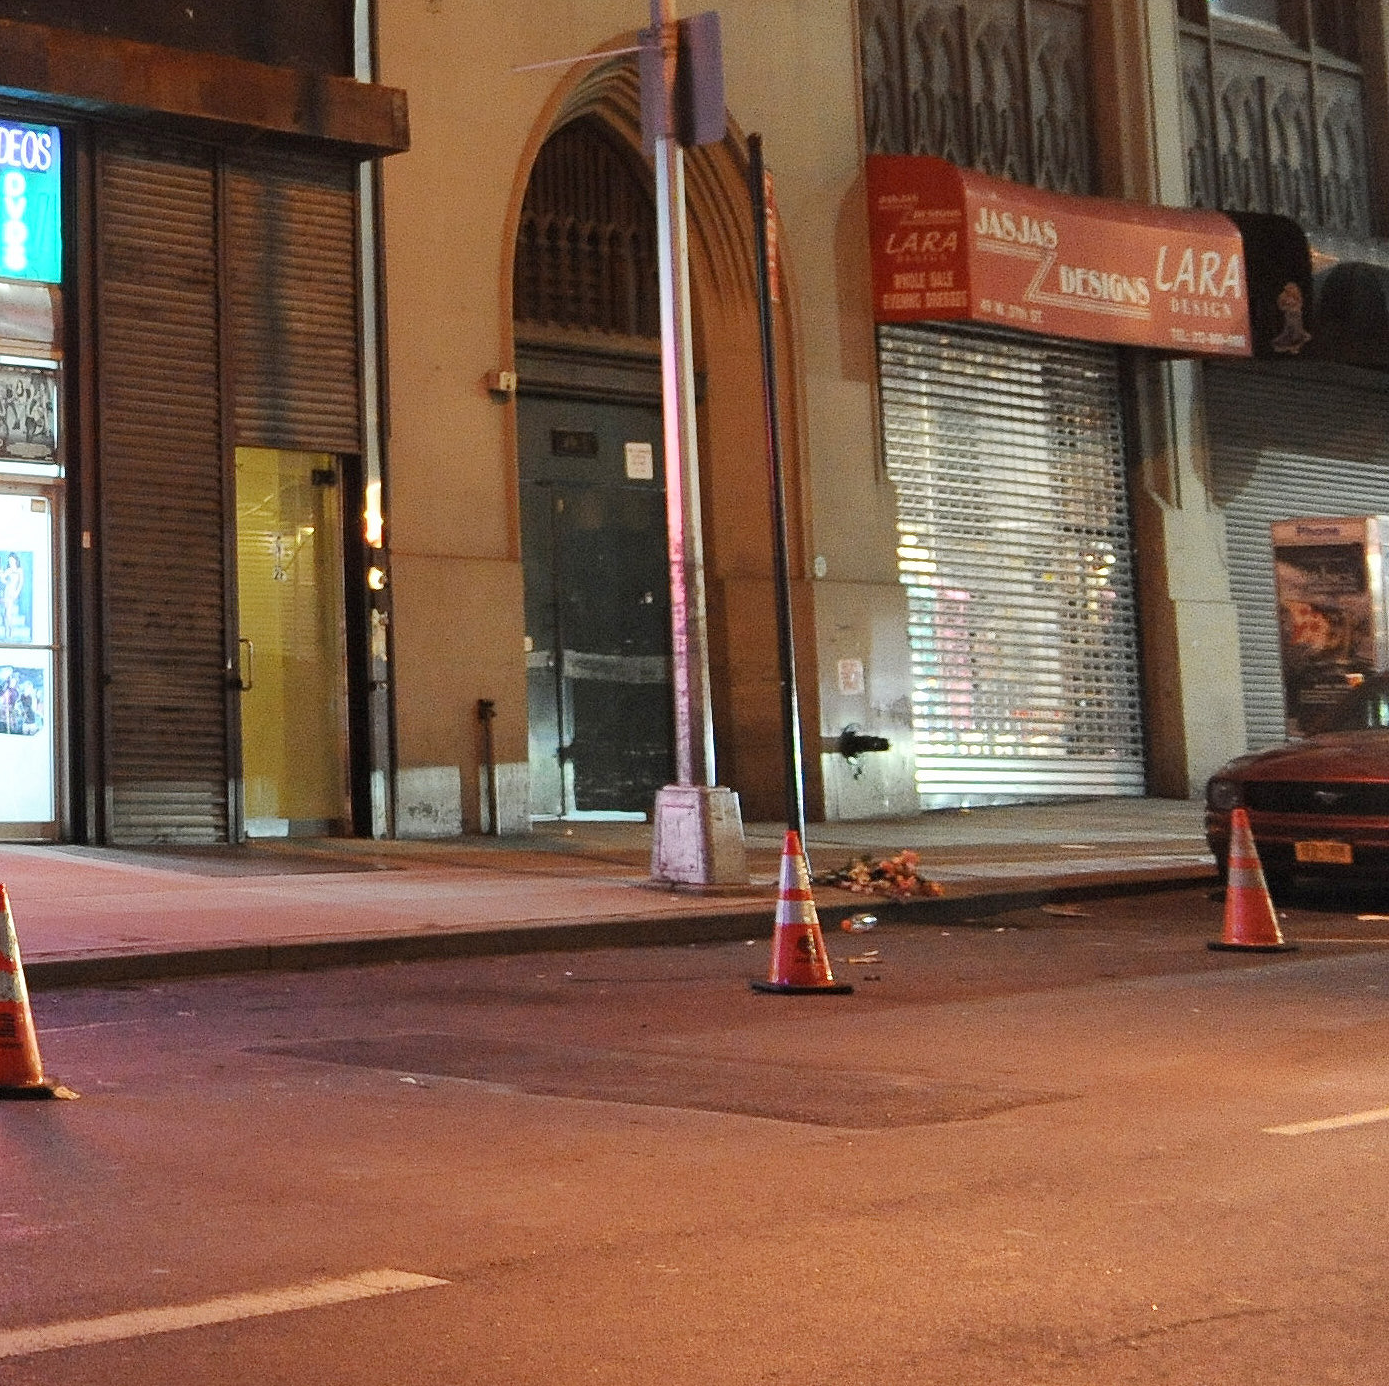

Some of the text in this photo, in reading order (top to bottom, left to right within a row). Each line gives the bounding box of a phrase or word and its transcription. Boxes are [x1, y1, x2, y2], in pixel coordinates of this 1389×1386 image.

[885, 231, 958, 254] LARA
[1059, 264, 1151, 307] DESIGNS
[1155, 245, 1242, 299] LARA
[1171, 297, 1233, 319] DESIGN
